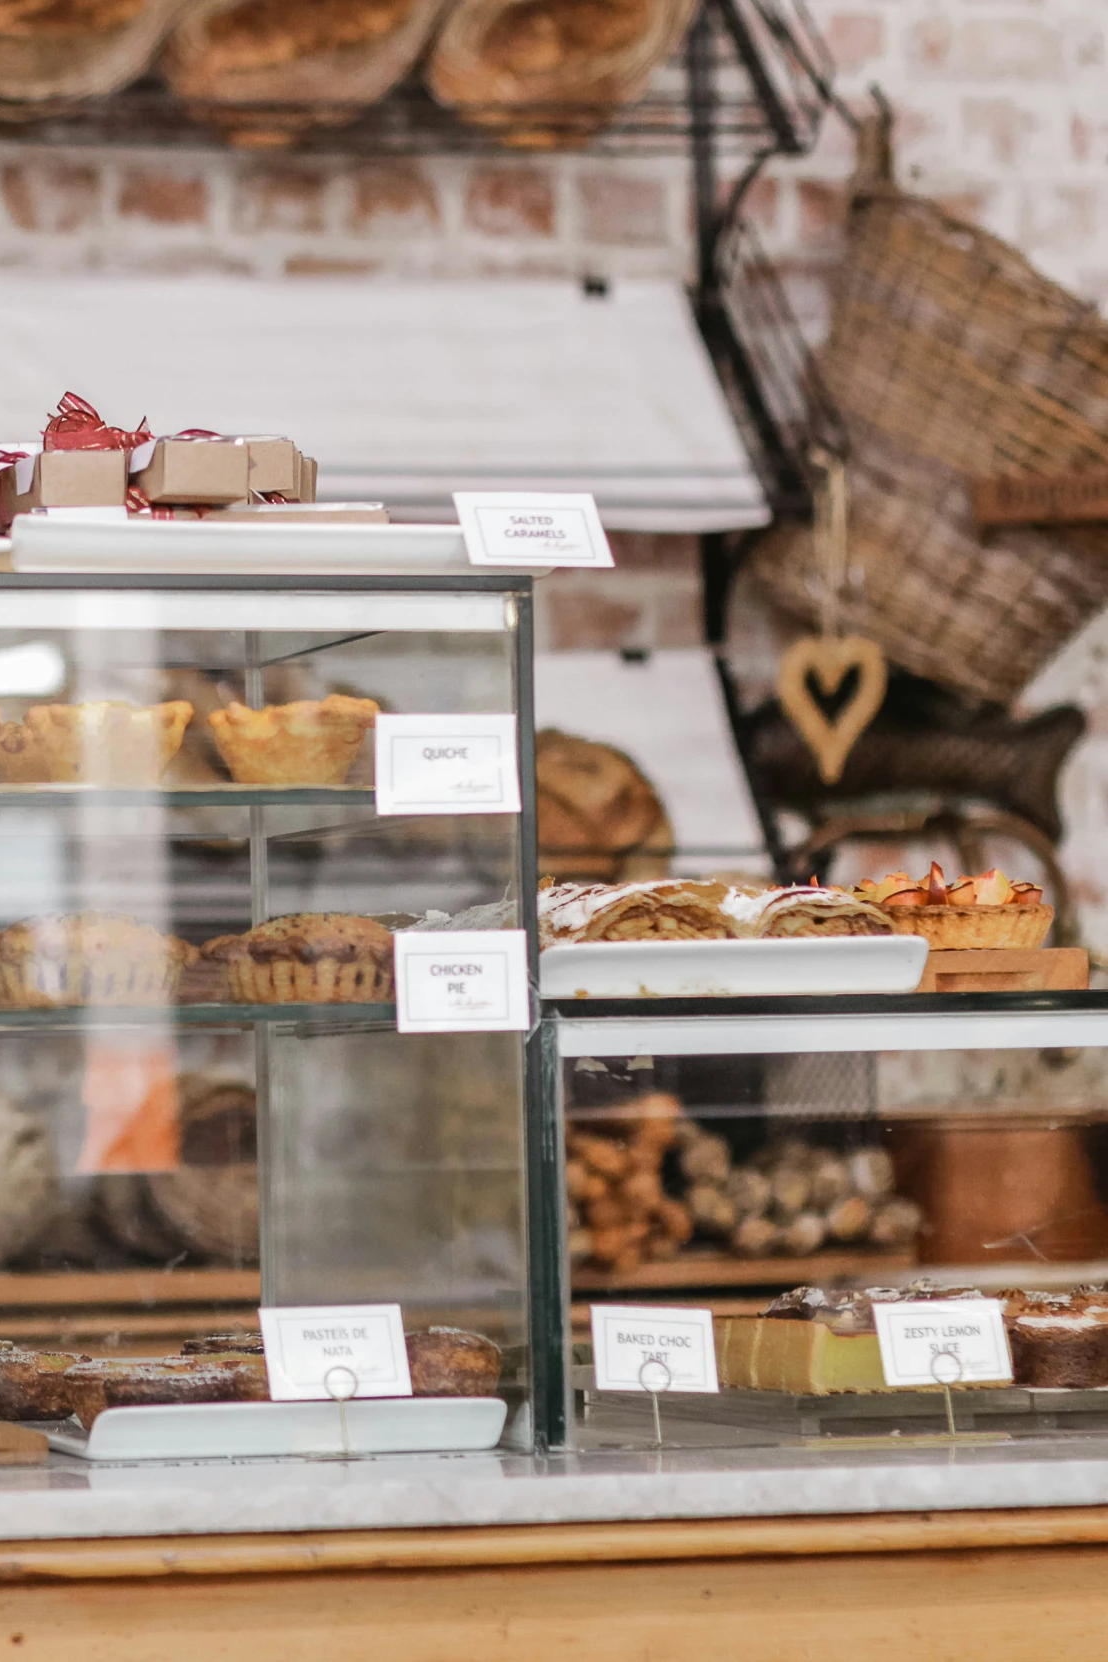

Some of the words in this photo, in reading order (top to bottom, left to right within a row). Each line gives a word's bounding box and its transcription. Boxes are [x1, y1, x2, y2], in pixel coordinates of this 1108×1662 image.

[509, 516, 554, 525] SALTED
[504, 529, 566, 539] CARAMELS
[423, 747, 469, 761] QUICHE
[430, 964, 483, 976] CHICKEN
[447, 983, 466, 994] PIE
[352, 1328, 369, 1340] DE
[904, 1327, 938, 1339] ZESTY
[942, 1325, 981, 1337] LEMON
[617, 1332, 655, 1346] BAKED
[658, 1335, 692, 1348] CHOC
[323, 1346, 353, 1357] NATA
[929, 1342, 961, 1354] SLICE
[641, 1351, 670, 1362] TART
